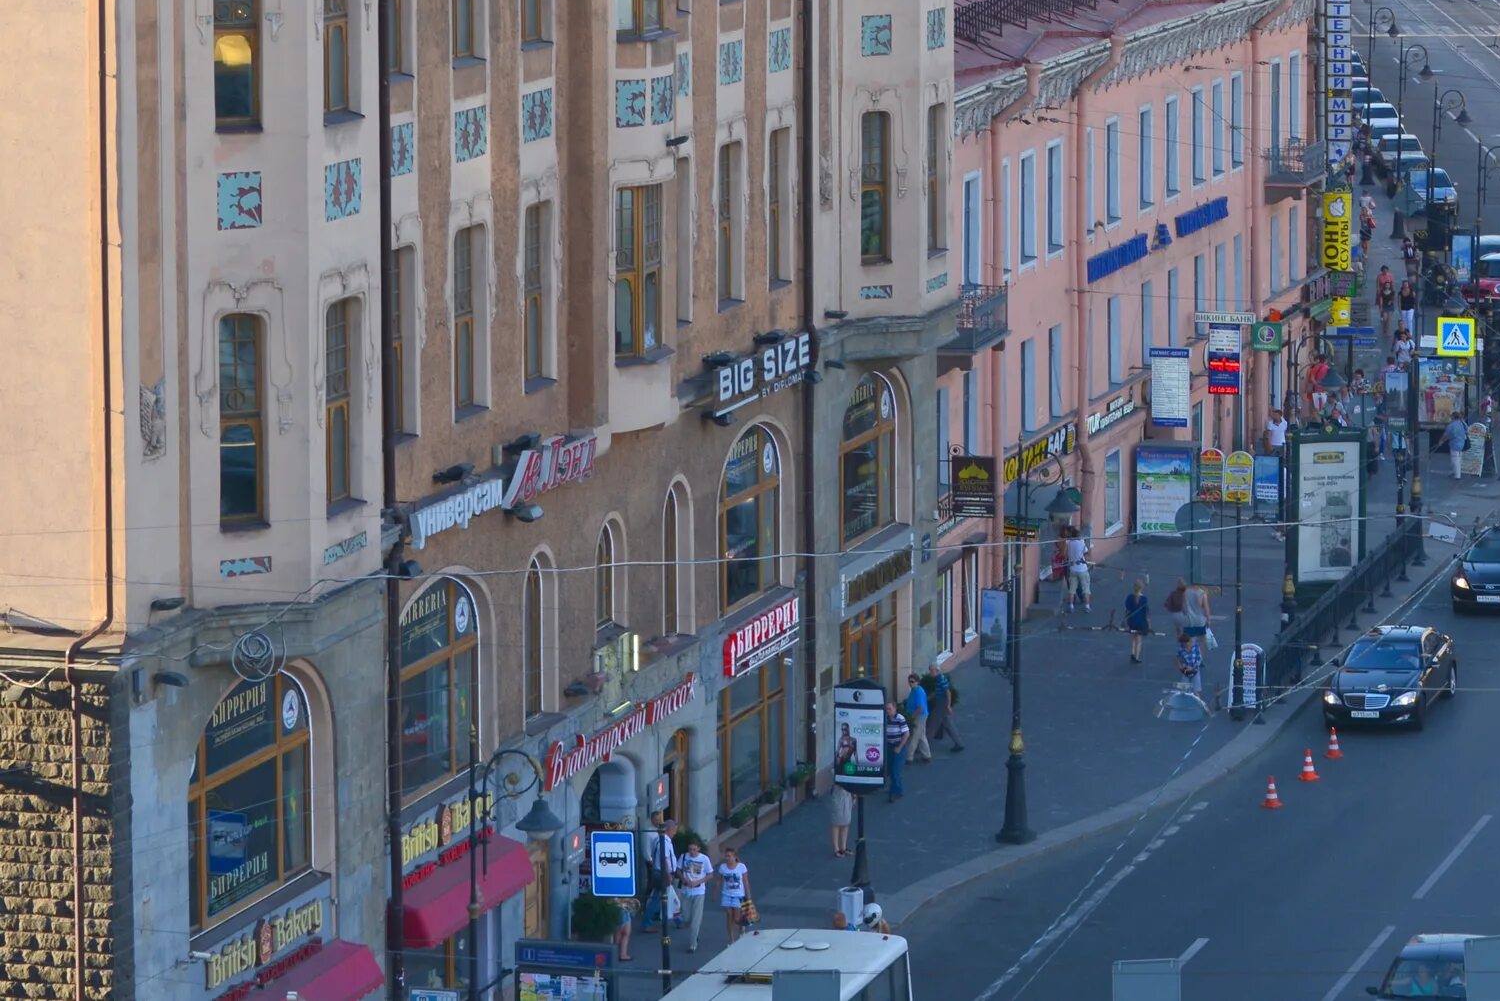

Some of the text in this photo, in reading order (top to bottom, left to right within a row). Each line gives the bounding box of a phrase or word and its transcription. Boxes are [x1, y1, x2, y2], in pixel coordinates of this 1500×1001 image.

[1332, 99, 1346, 138] МИР
[720, 333, 810, 402] BIG SIZE
[762, 370, 807, 398] BY DIPLOMAT
[1048, 427, 1066, 458] БАР
[411, 478, 503, 550] универсам
[736, 597, 800, 659] БИРРЕРИЯ
[546, 703, 647, 791] Владимирский
[401, 822, 439, 866] British
[210, 852, 269, 900] БИРРЕРИЯ
[210, 899, 323, 988] British Bakery
